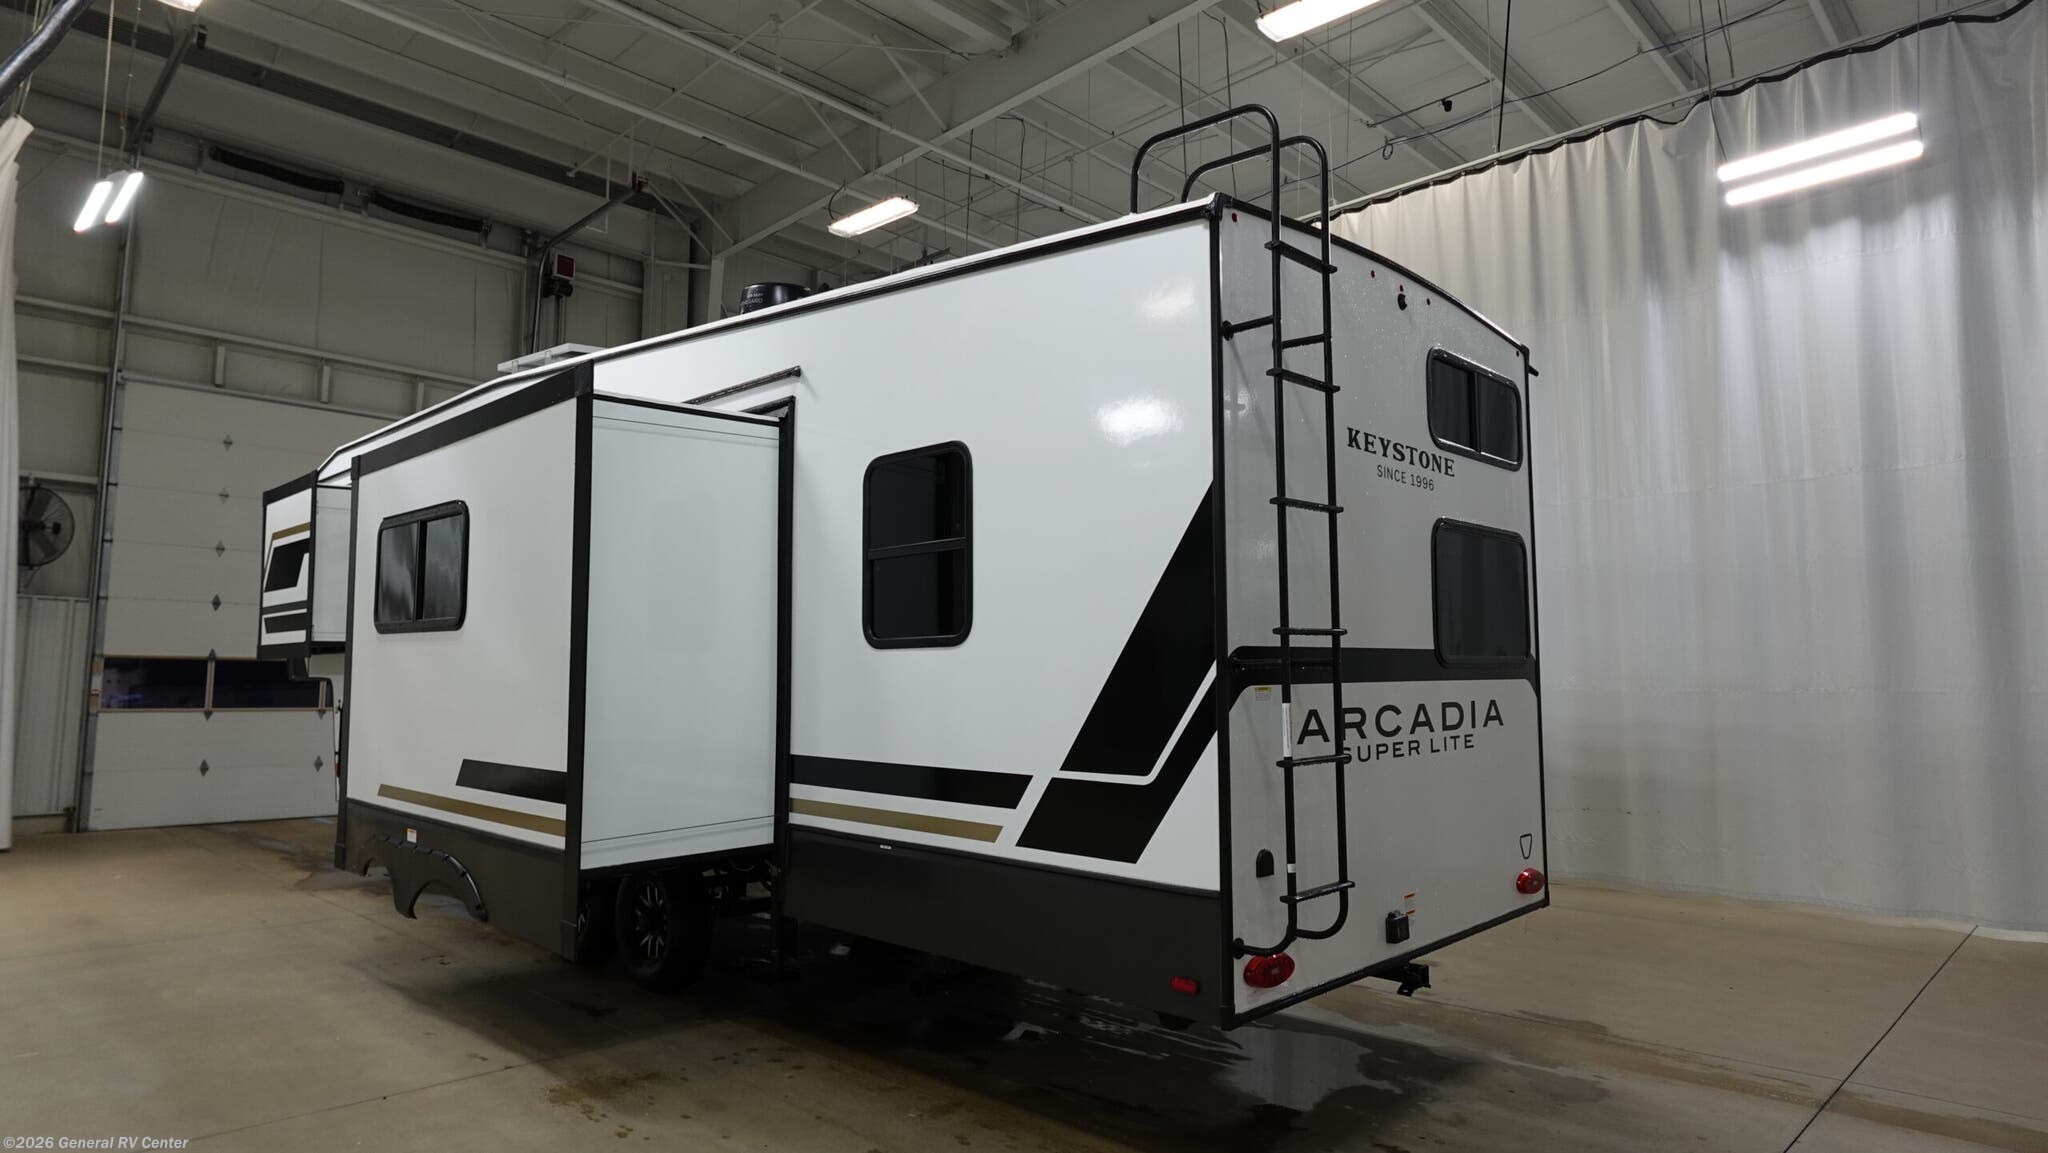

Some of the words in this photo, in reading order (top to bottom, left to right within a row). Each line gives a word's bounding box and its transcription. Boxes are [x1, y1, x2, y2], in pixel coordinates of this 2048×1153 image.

[1347, 426, 1455, 477] KEYSTONE
[1377, 464, 1406, 484] SINCE
[1411, 474, 1434, 491] 1996
[1297, 699, 1504, 745] ARCADIA
[1342, 739, 1420, 764] SUPER
[1430, 733, 1474, 753] LITE
